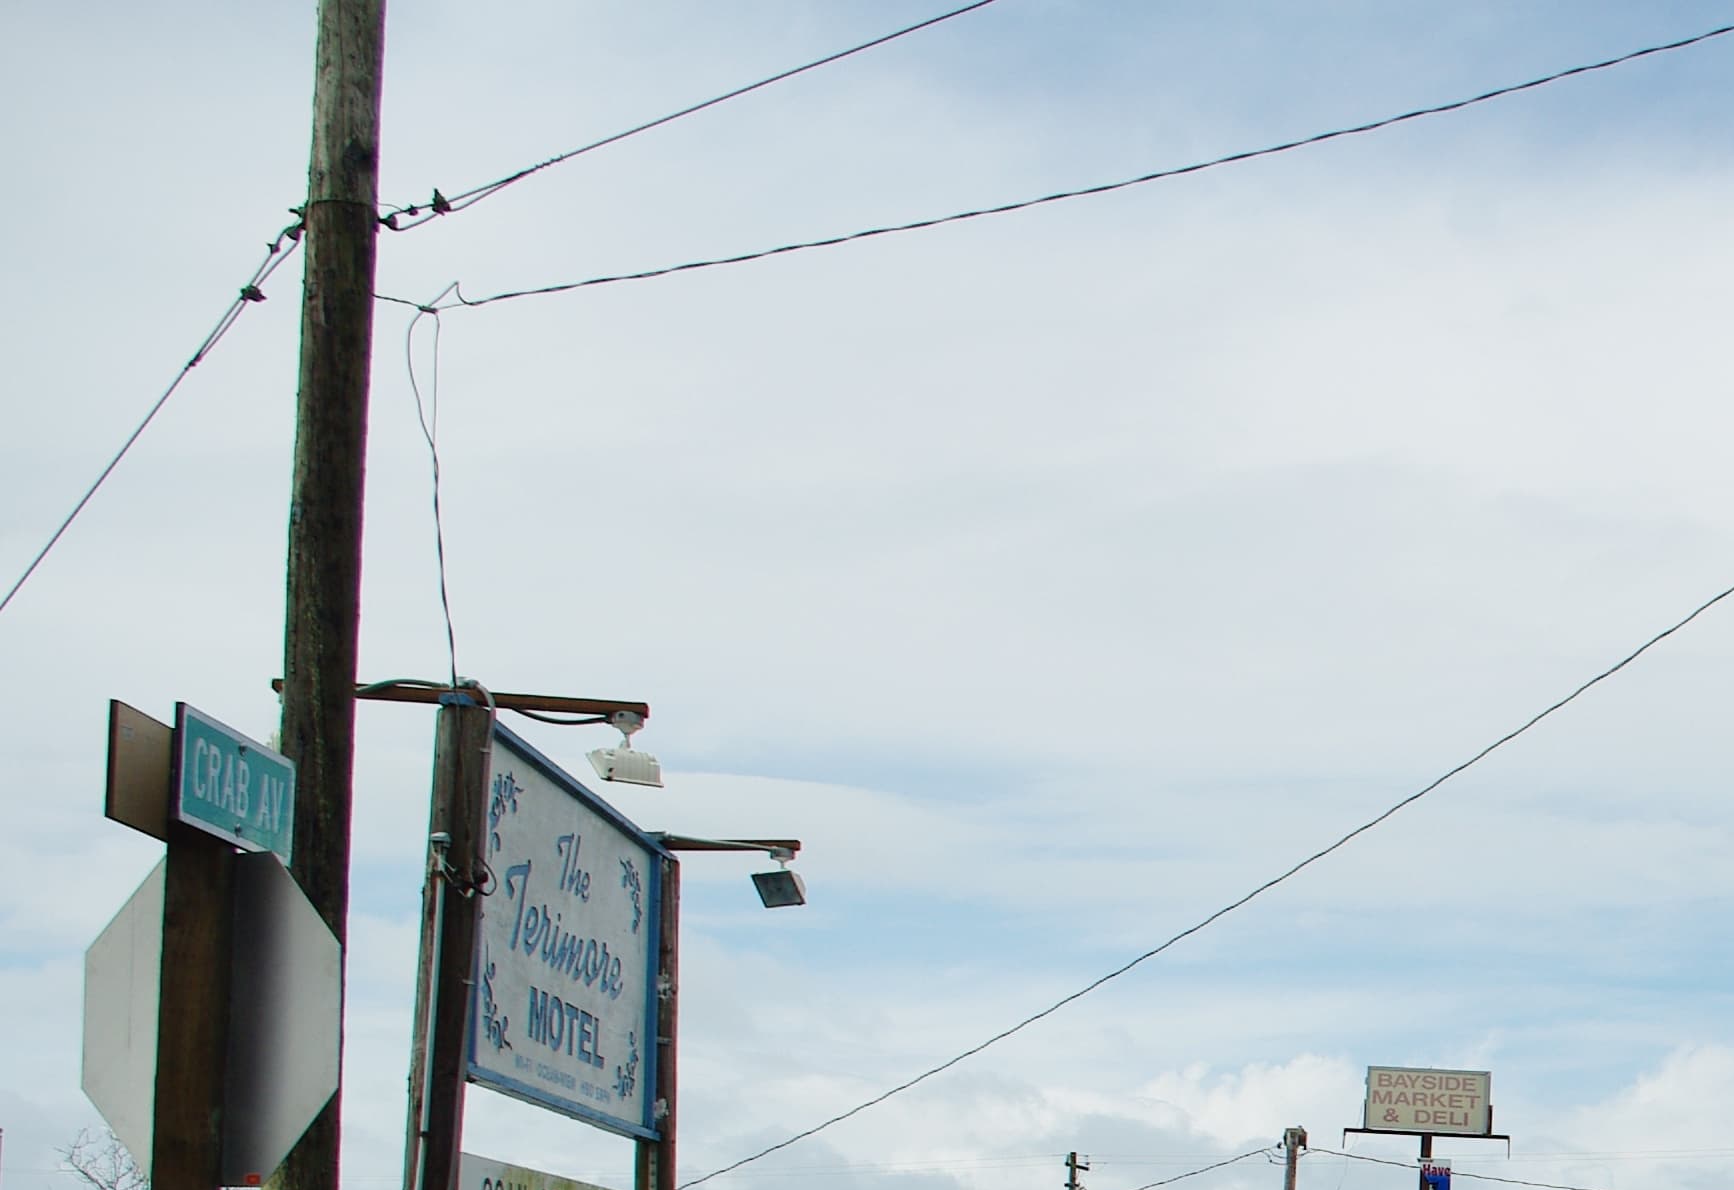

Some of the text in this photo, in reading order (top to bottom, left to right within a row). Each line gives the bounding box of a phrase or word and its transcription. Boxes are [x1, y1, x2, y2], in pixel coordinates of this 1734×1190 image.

[192, 737, 285, 834] CRAB AV
[557, 832, 591, 903] The
[506, 859, 624, 1001] Terimore
[528, 985, 605, 1070] MOTEL
[1371, 1090, 1481, 1109] MARKET
[1377, 1073, 1477, 1092] BAYSIDE
[1383, 1108, 1469, 1127] & DELI
[1421, 1164, 1451, 1177] Have
